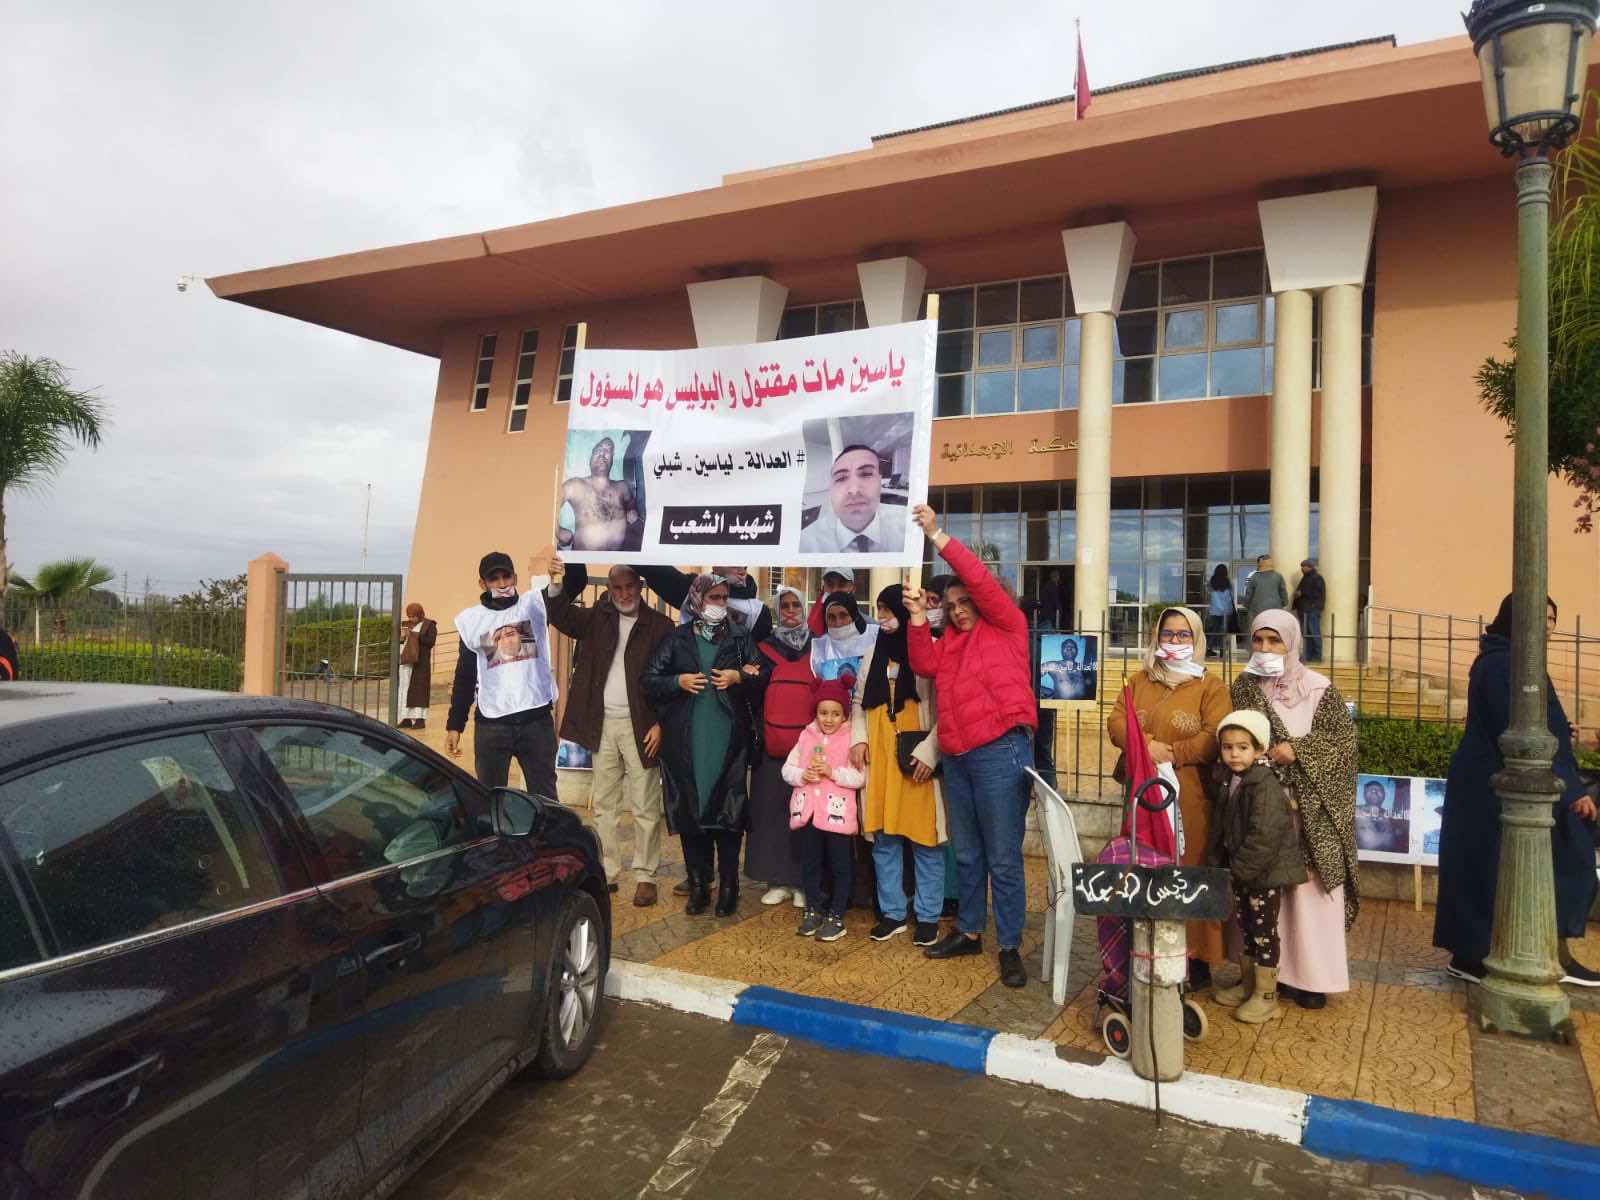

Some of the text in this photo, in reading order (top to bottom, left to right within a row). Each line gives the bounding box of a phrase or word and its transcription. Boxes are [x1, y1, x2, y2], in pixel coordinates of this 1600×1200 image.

[579, 347, 906, 411] ياسين مات مقتول و البوليس هو المسؤول
[653, 451, 682, 479] شبلي
[695, 452, 734, 477] لياسين
[745, 450, 792, 470] العدالة
[669, 509, 775, 541] شهيد الشعب
[1146, 869, 1209, 907] رئيس
